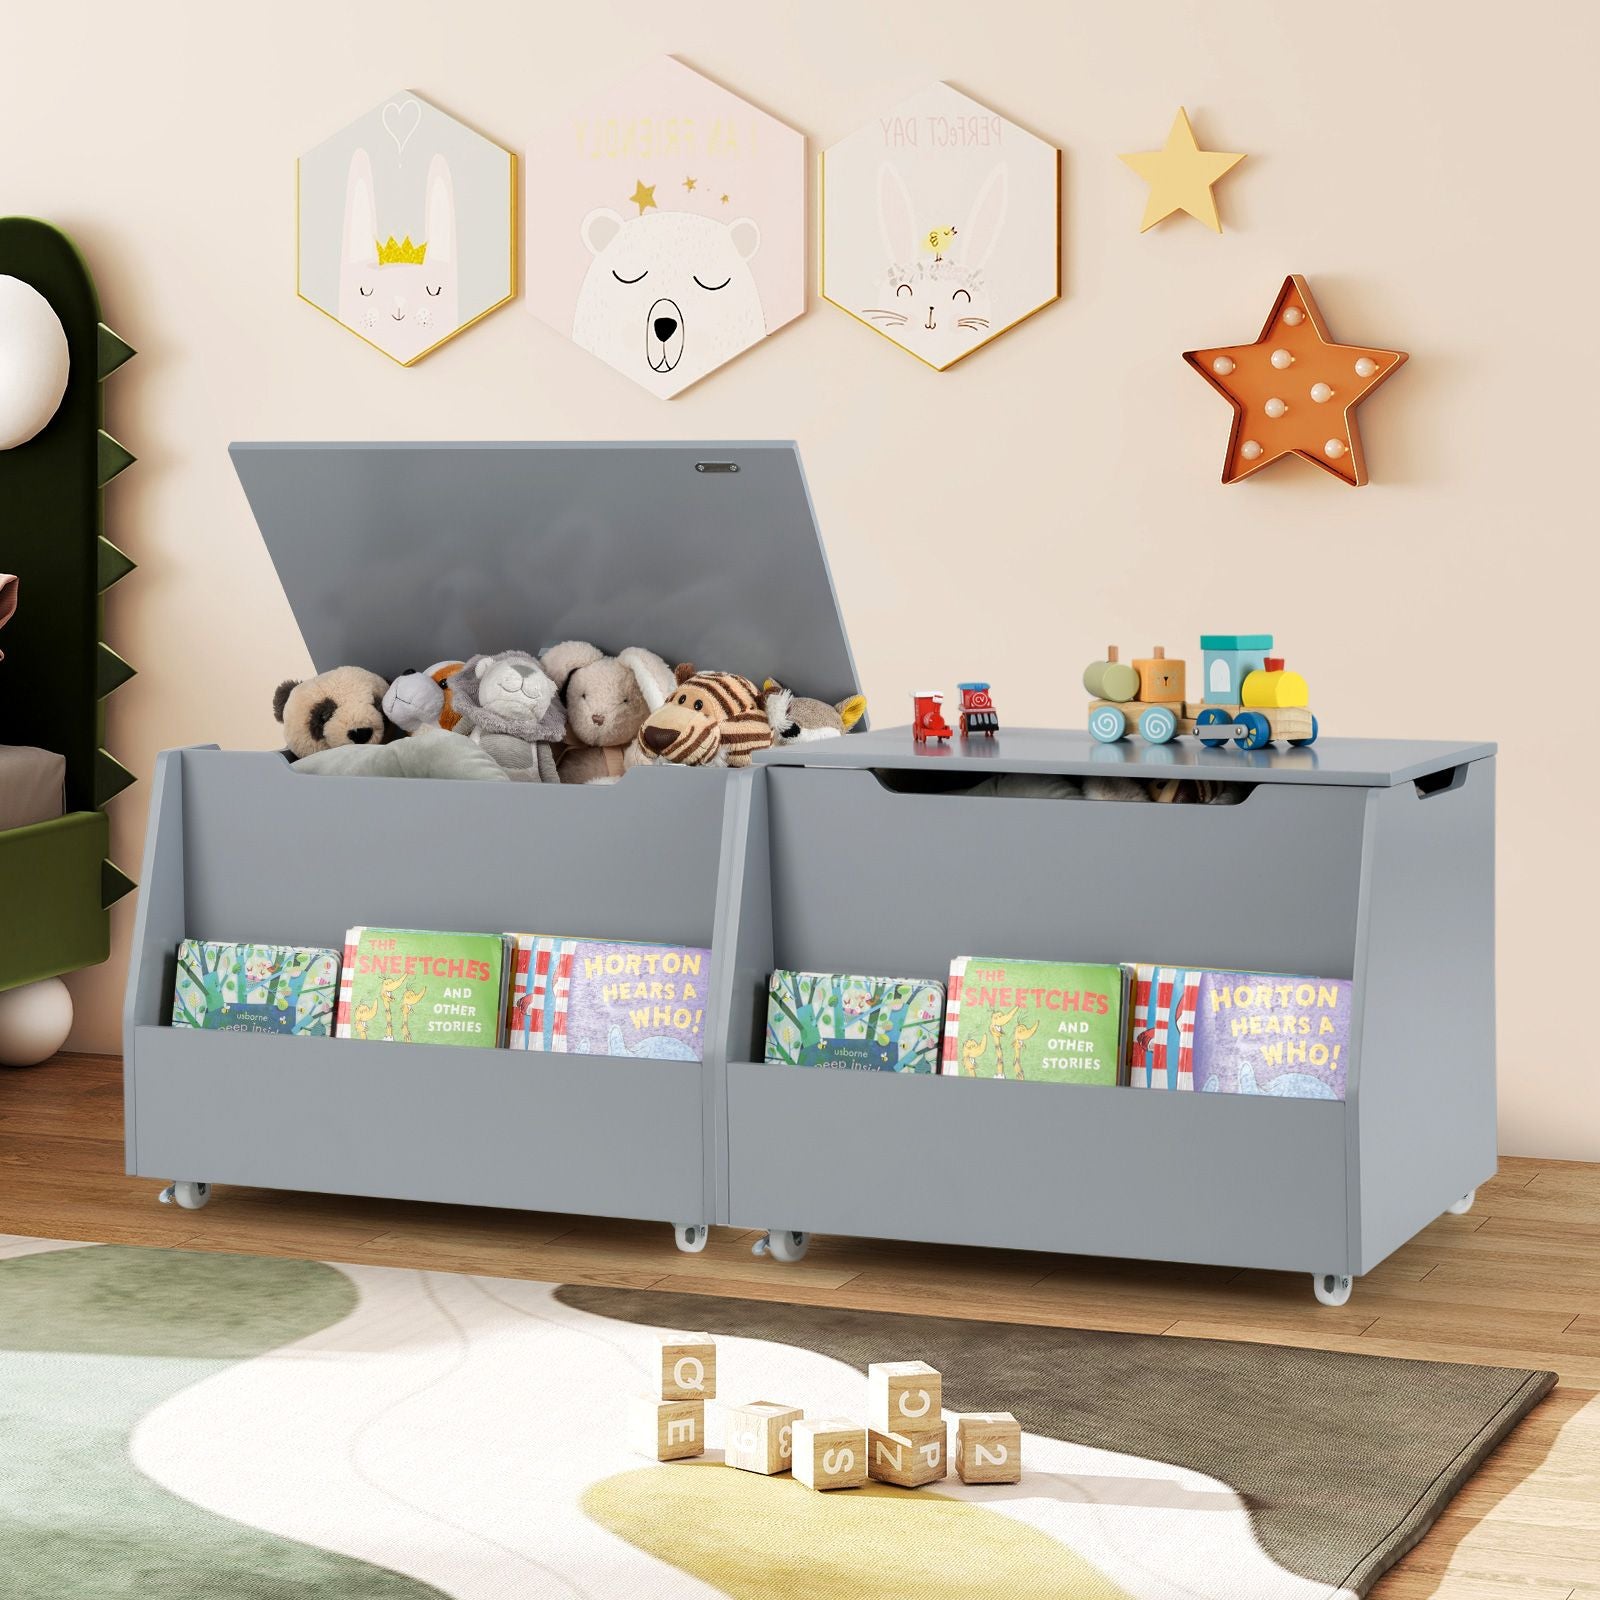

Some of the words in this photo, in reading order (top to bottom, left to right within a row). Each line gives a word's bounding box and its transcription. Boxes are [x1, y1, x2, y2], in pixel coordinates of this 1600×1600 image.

[368, 938, 396, 951] THE
[357, 955, 491, 982] SNEETCHES
[583, 952, 702, 980] HORTON
[975, 969, 1005, 983] THE
[442, 987, 472, 1000] AND
[602, 981, 675, 1003] HEARS
[682, 982, 697, 1001] A
[964, 986, 1110, 1016] SNEETCHES
[1210, 983, 1339, 1013] HORTON
[236, 1011, 268, 1022] usborne
[433, 1003, 476, 1017] OTHER
[628, 1005, 703, 1034] WHO!
[427, 1019, 482, 1033] STORIES
[1057, 1021, 1090, 1034] AND
[1231, 1015, 1311, 1037] HEARS
[1319, 1015, 1336, 1036] A
[834, 1047, 869, 1058] usborne
[1047, 1038, 1095, 1053] OTHER
[1259, 1040, 1342, 1071] WHO!
[1041, 1056, 1101, 1071] STORIES
[673, 1356, 705, 1391] Q
[898, 1389, 931, 1418] C
[667, 1418, 695, 1446] E
[822, 1448, 855, 1475] S
[919, 1441, 941, 1468] P
[975, 1443, 1008, 1466] 2
